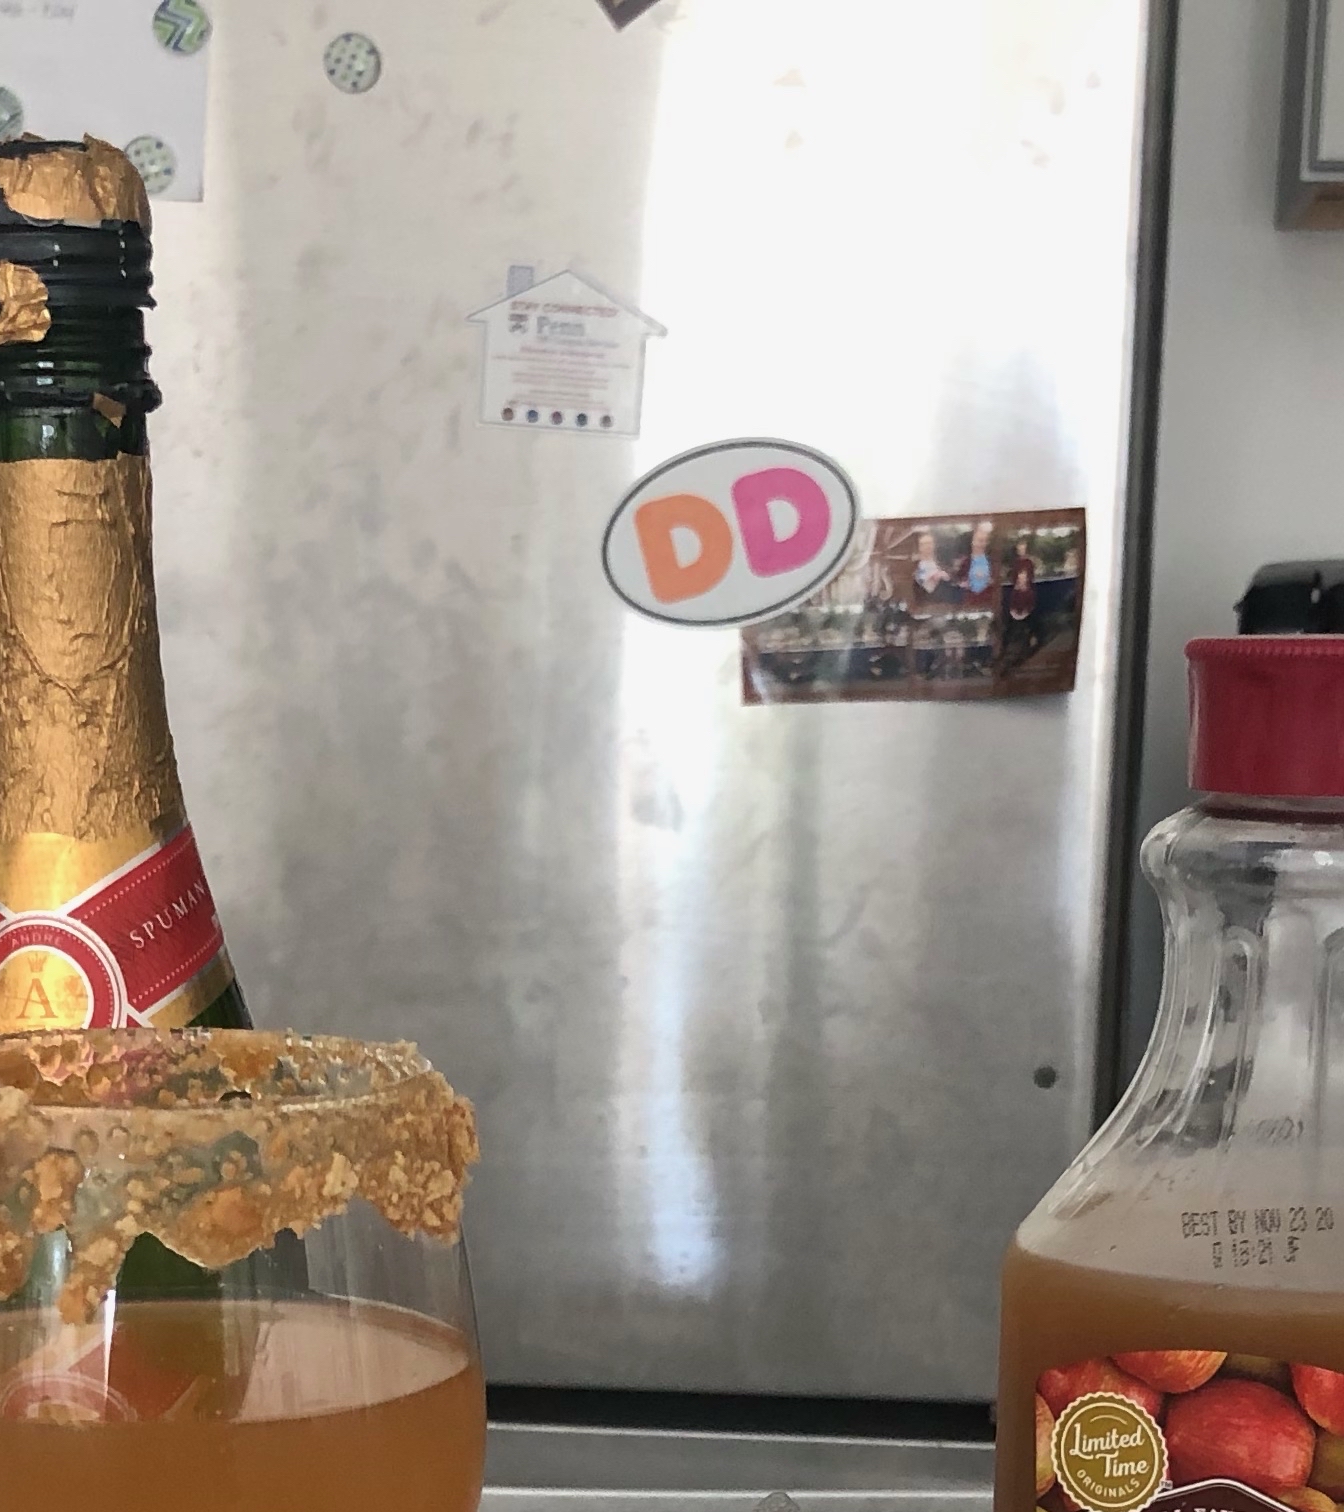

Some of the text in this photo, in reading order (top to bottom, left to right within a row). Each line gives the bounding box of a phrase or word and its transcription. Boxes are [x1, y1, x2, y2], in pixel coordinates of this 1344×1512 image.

[633, 466, 832, 605] DD
[1069, 1423, 1146, 1460] Limited
[1095, 1451, 1150, 1477] Time
[1077, 1469, 1140, 1497] ORIGINALS
